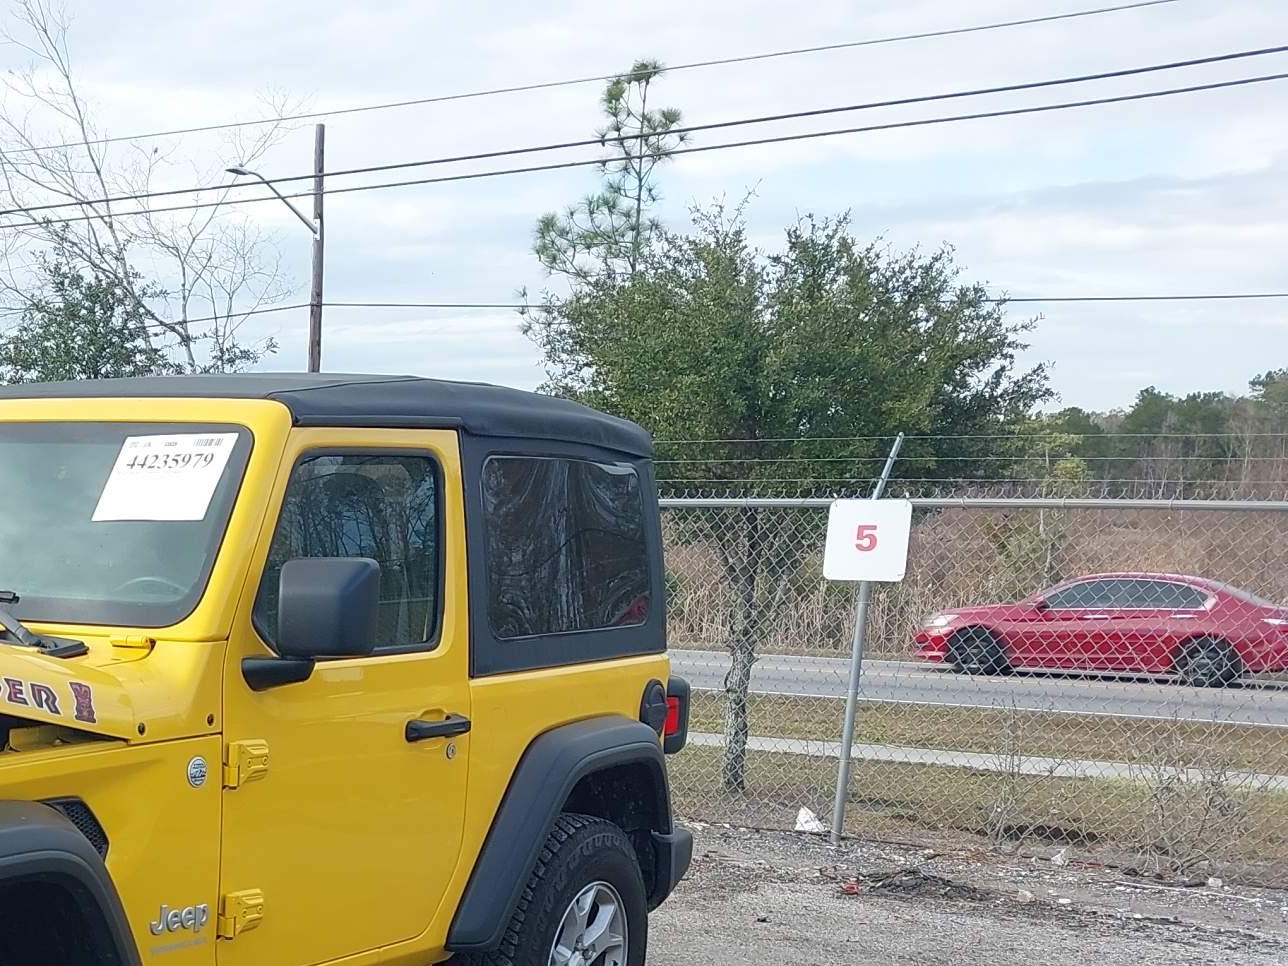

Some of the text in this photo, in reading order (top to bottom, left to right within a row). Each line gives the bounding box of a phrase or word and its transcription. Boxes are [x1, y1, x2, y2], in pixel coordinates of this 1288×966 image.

[126, 453, 214, 469] 44235979
[855, 525, 878, 552] 5
[150, 903, 209, 936] Jeep
